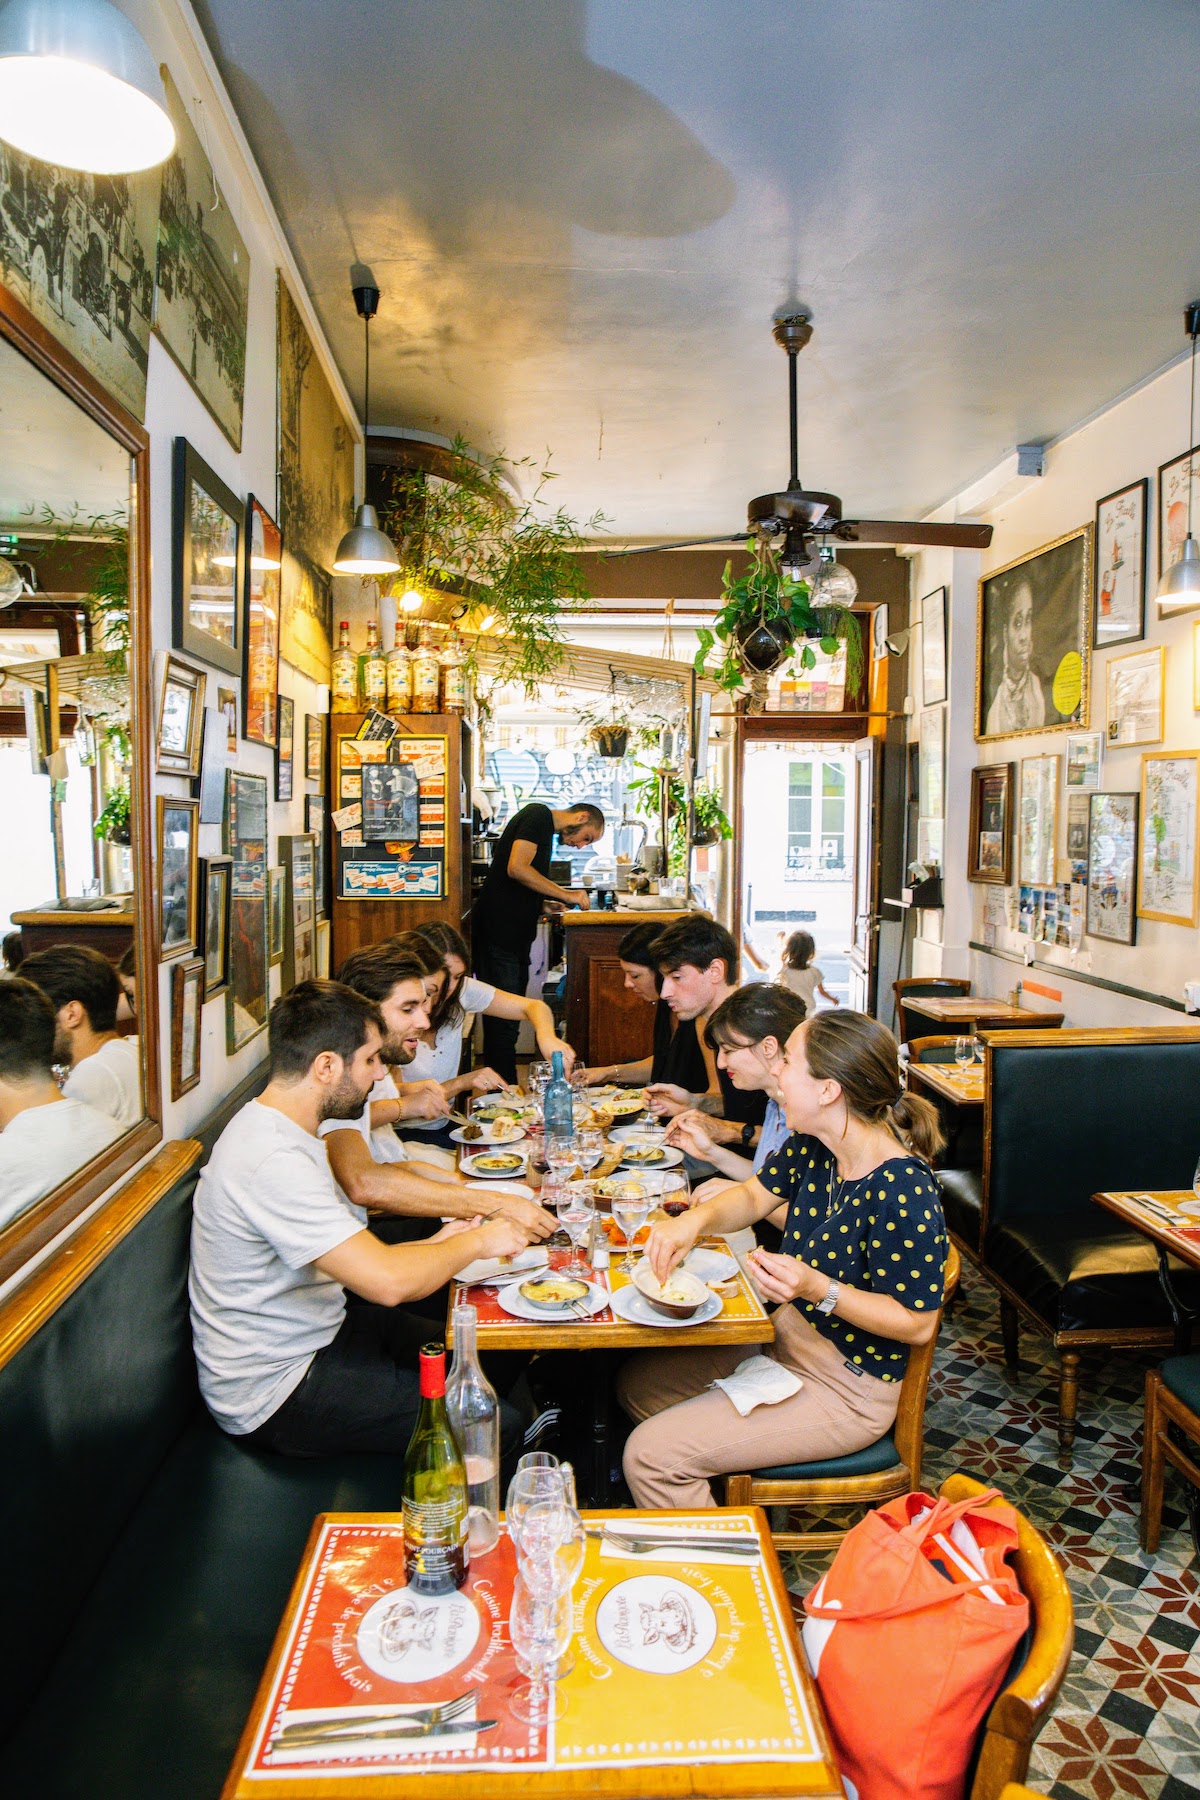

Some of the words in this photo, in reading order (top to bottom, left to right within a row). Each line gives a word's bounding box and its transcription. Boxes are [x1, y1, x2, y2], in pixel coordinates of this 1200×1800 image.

[681, 1566, 713, 1588] frais
[472, 1579, 500, 1618] Cuisine
[710, 1585, 744, 1627] produits
[340, 1606, 363, 1620] de
[331, 1622, 353, 1669] produits
[719, 1628, 740, 1642] de
[577, 1636, 612, 1680] Cuisine
[704, 1645, 736, 1670] base
[340, 1665, 373, 1692] frais
